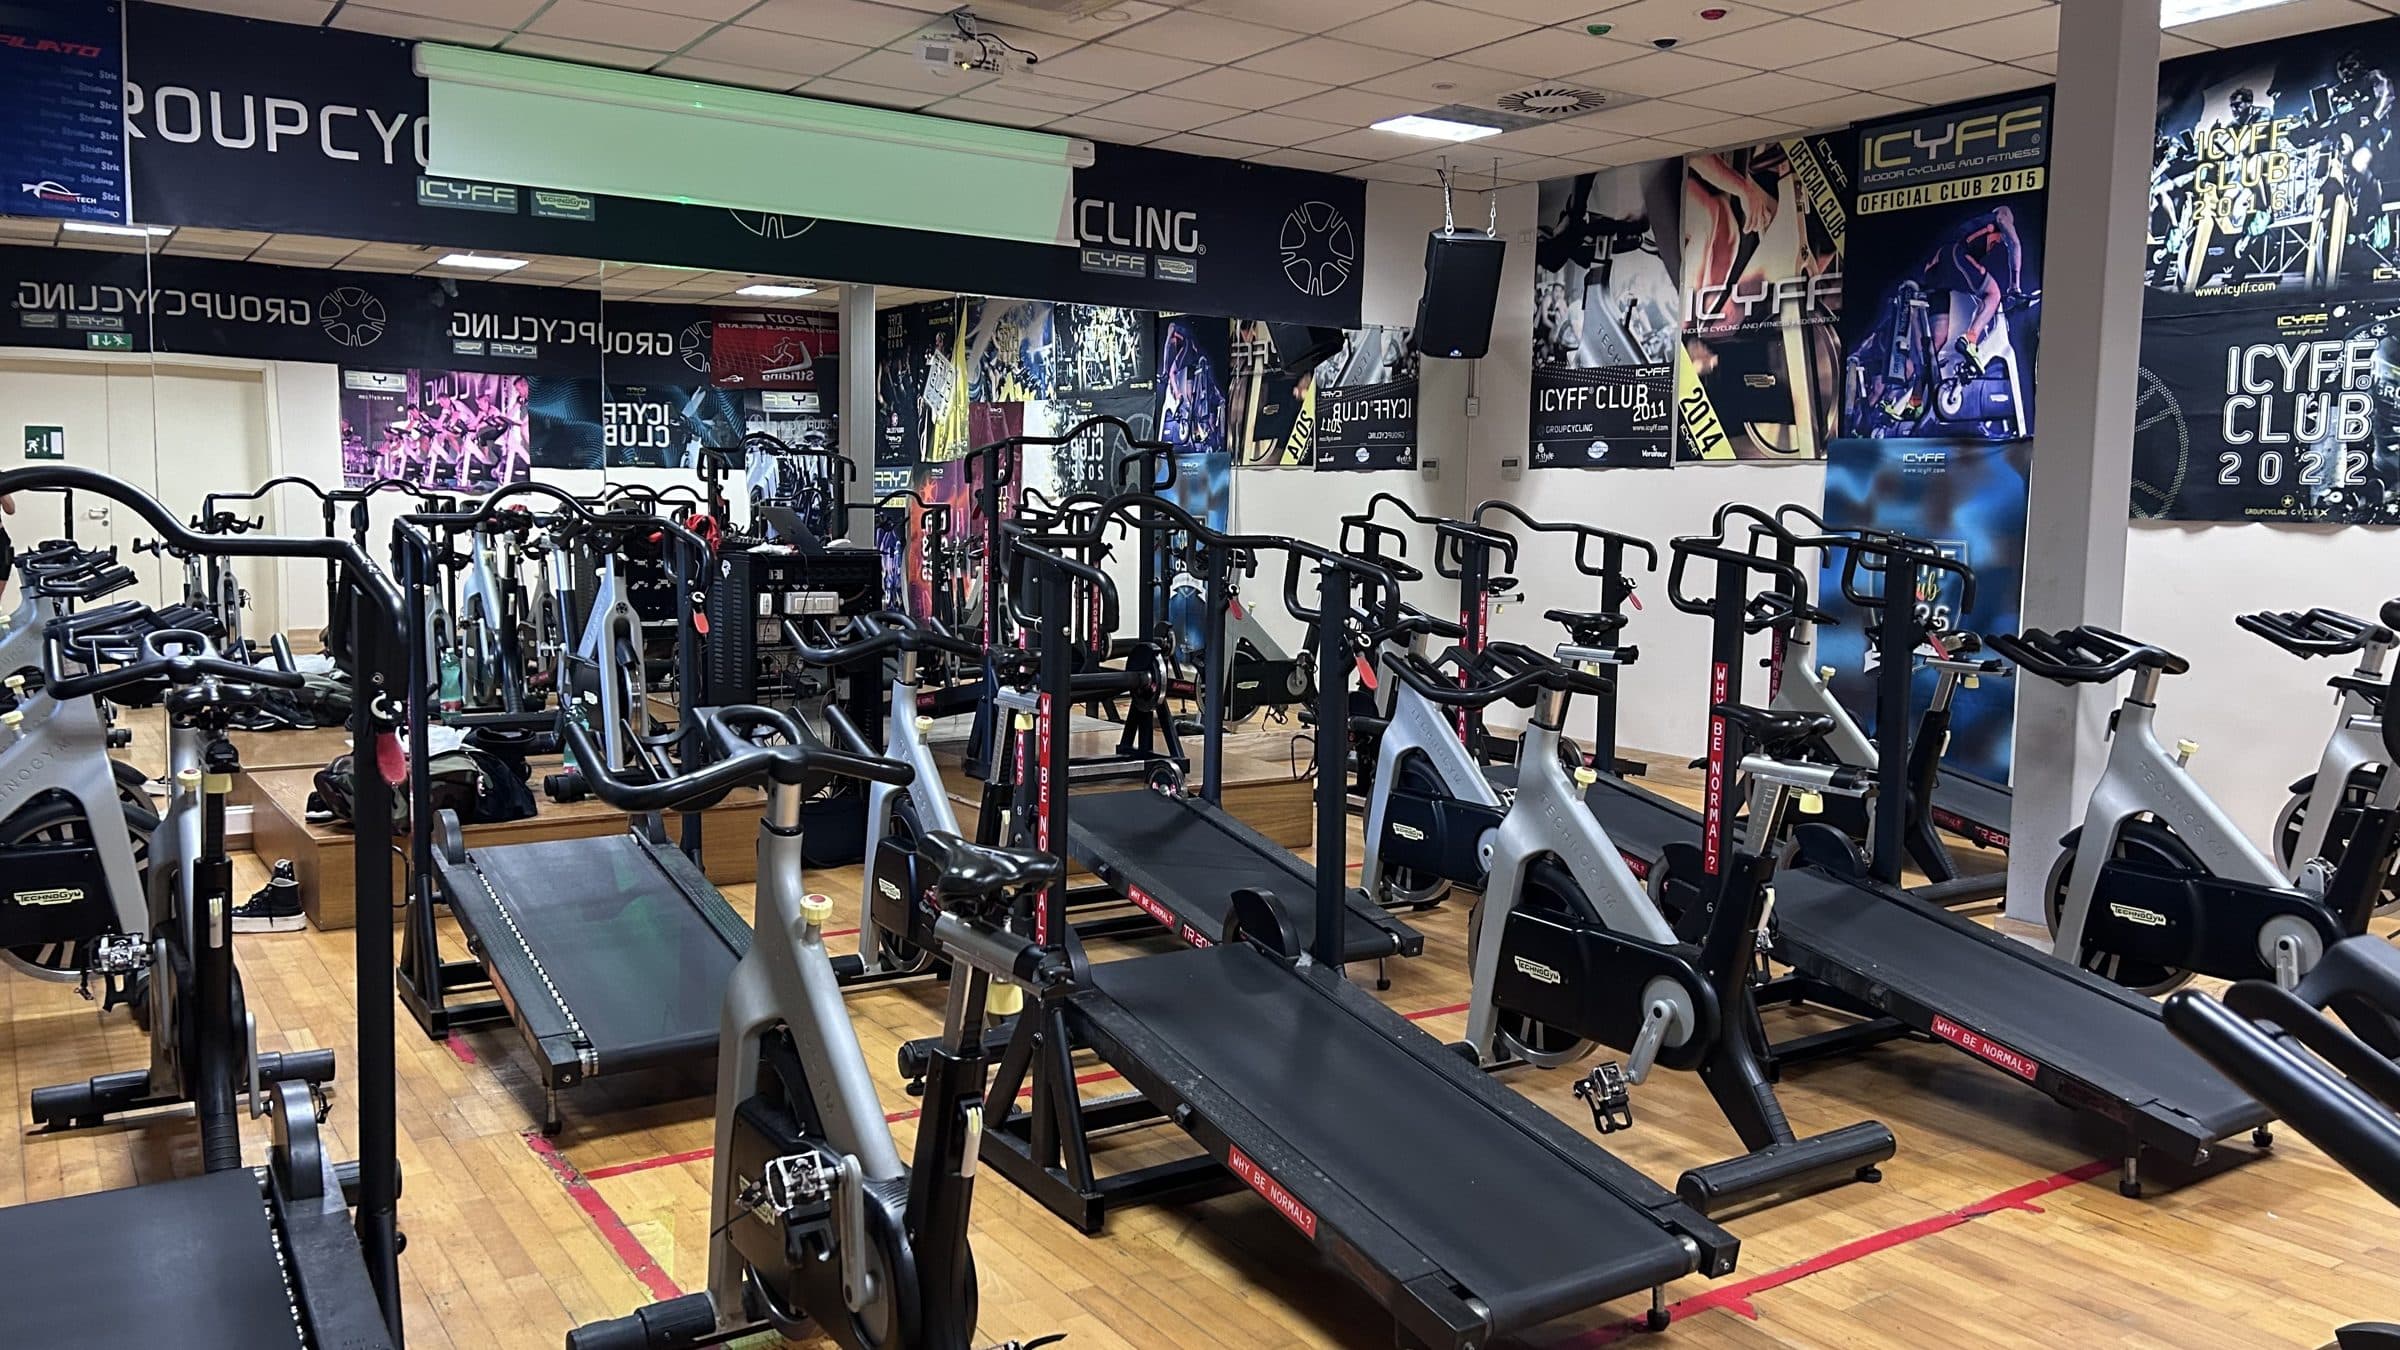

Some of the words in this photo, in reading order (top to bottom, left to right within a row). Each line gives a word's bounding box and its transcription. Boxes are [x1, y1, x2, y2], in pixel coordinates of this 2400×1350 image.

[1864, 106, 2043, 171] ICYFF
[2197, 118, 2292, 161] ICYFF
[1789, 140, 1828, 205] OFFICIAL
[1958, 156, 1984, 168] AND
[2194, 152, 2290, 193] CLUB
[420, 180, 515, 203] ICYFF
[1860, 187, 1932, 213] OFFICIAL
[1940, 179, 1982, 201] CLUB
[1991, 170, 2036, 194] 2015
[1082, 250, 1145, 269] ICYFF
[1685, 272, 1843, 322] ICYFF
[2194, 281, 2276, 297] www.icyff.com
[2277, 313, 2329, 326] ICYFF
[1635, 366, 1671, 378] ICYFF
[1595, 383, 1649, 409] CLUB
[1632, 400, 1667, 422] 2011
[1545, 423, 1593, 433] GROUPCYCLING
[1679, 387, 1725, 454] 2014
[2222, 391, 2374, 445] CLUB
[1902, 453, 1945, 462] ICYFF
[2218, 450, 2369, 485] 2022
[1040, 698, 1050, 753] WHY
[1713, 721, 1723, 751] BE
[1040, 766, 1049, 803] BE
[1708, 760, 1721, 870] NORMAL?
[1706, 902, 1713, 913] 6
[1183, 924, 1195, 942] TR
[1517, 957, 1559, 982] TECHNOGYM
[1936, 1020, 1957, 1038] WHY
[1962, 1032, 1977, 1048] BE
[1982, 1042, 2033, 1074] NORMAL?
[1233, 1152, 1250, 1175] WHY
[1254, 1171, 1266, 1190] BE
[1270, 1185, 1312, 1229] NORMAL?
